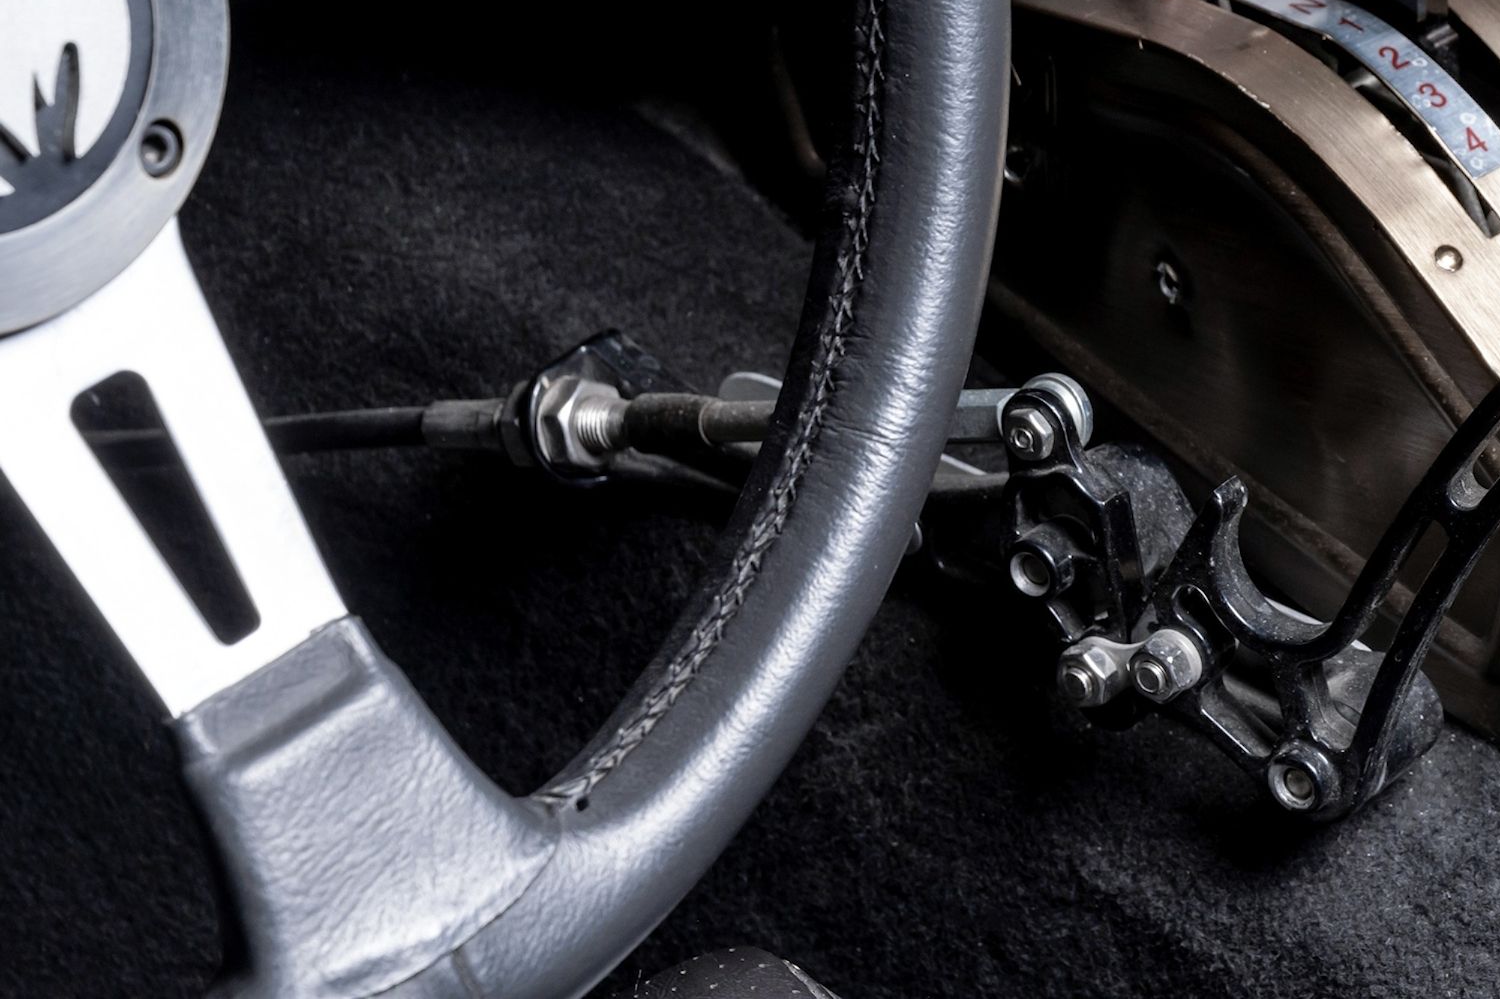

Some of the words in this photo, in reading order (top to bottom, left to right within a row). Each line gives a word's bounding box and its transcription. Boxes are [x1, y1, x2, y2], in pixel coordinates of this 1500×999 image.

[1338, 17, 1364, 34] 1
[1379, 46, 1411, 70] 2
[1419, 83, 1447, 108] 3
[1465, 127, 1489, 152] 4
